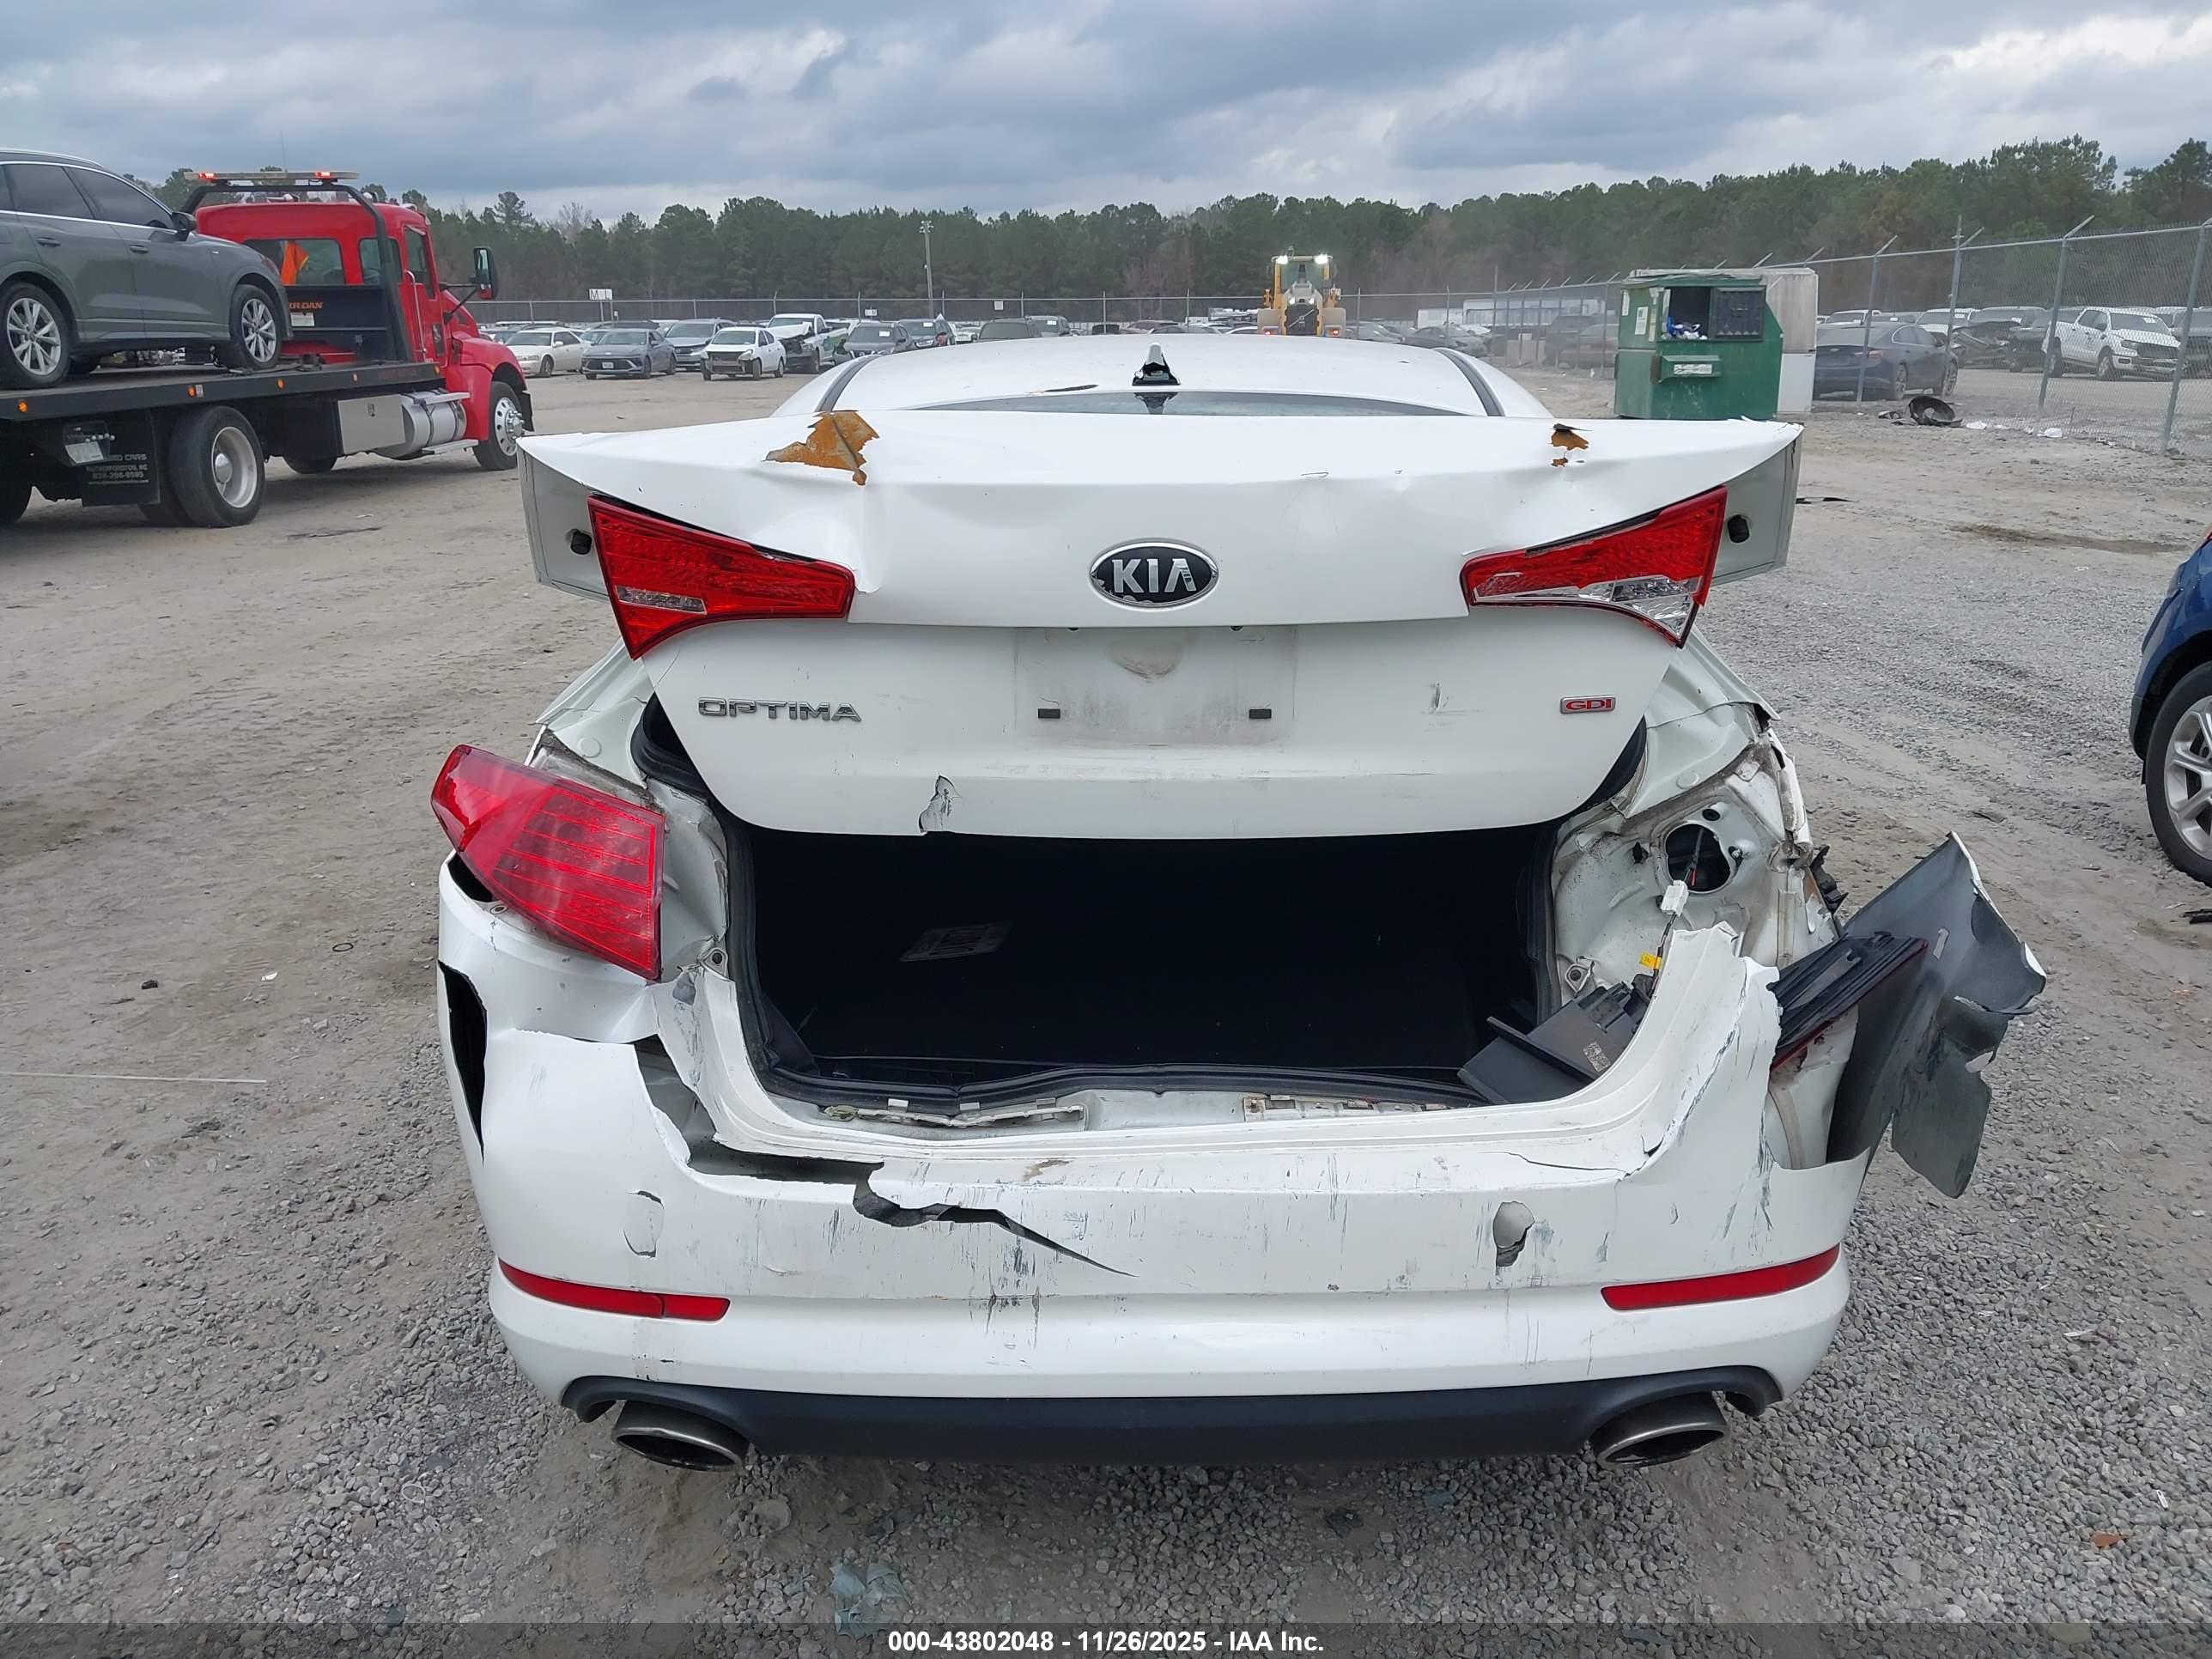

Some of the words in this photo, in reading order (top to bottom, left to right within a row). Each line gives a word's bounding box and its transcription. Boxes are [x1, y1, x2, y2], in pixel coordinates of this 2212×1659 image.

[1111, 558, 1197, 593] KIA
[698, 696, 862, 721] OPTIMA
[1565, 699, 1612, 710] GDI
